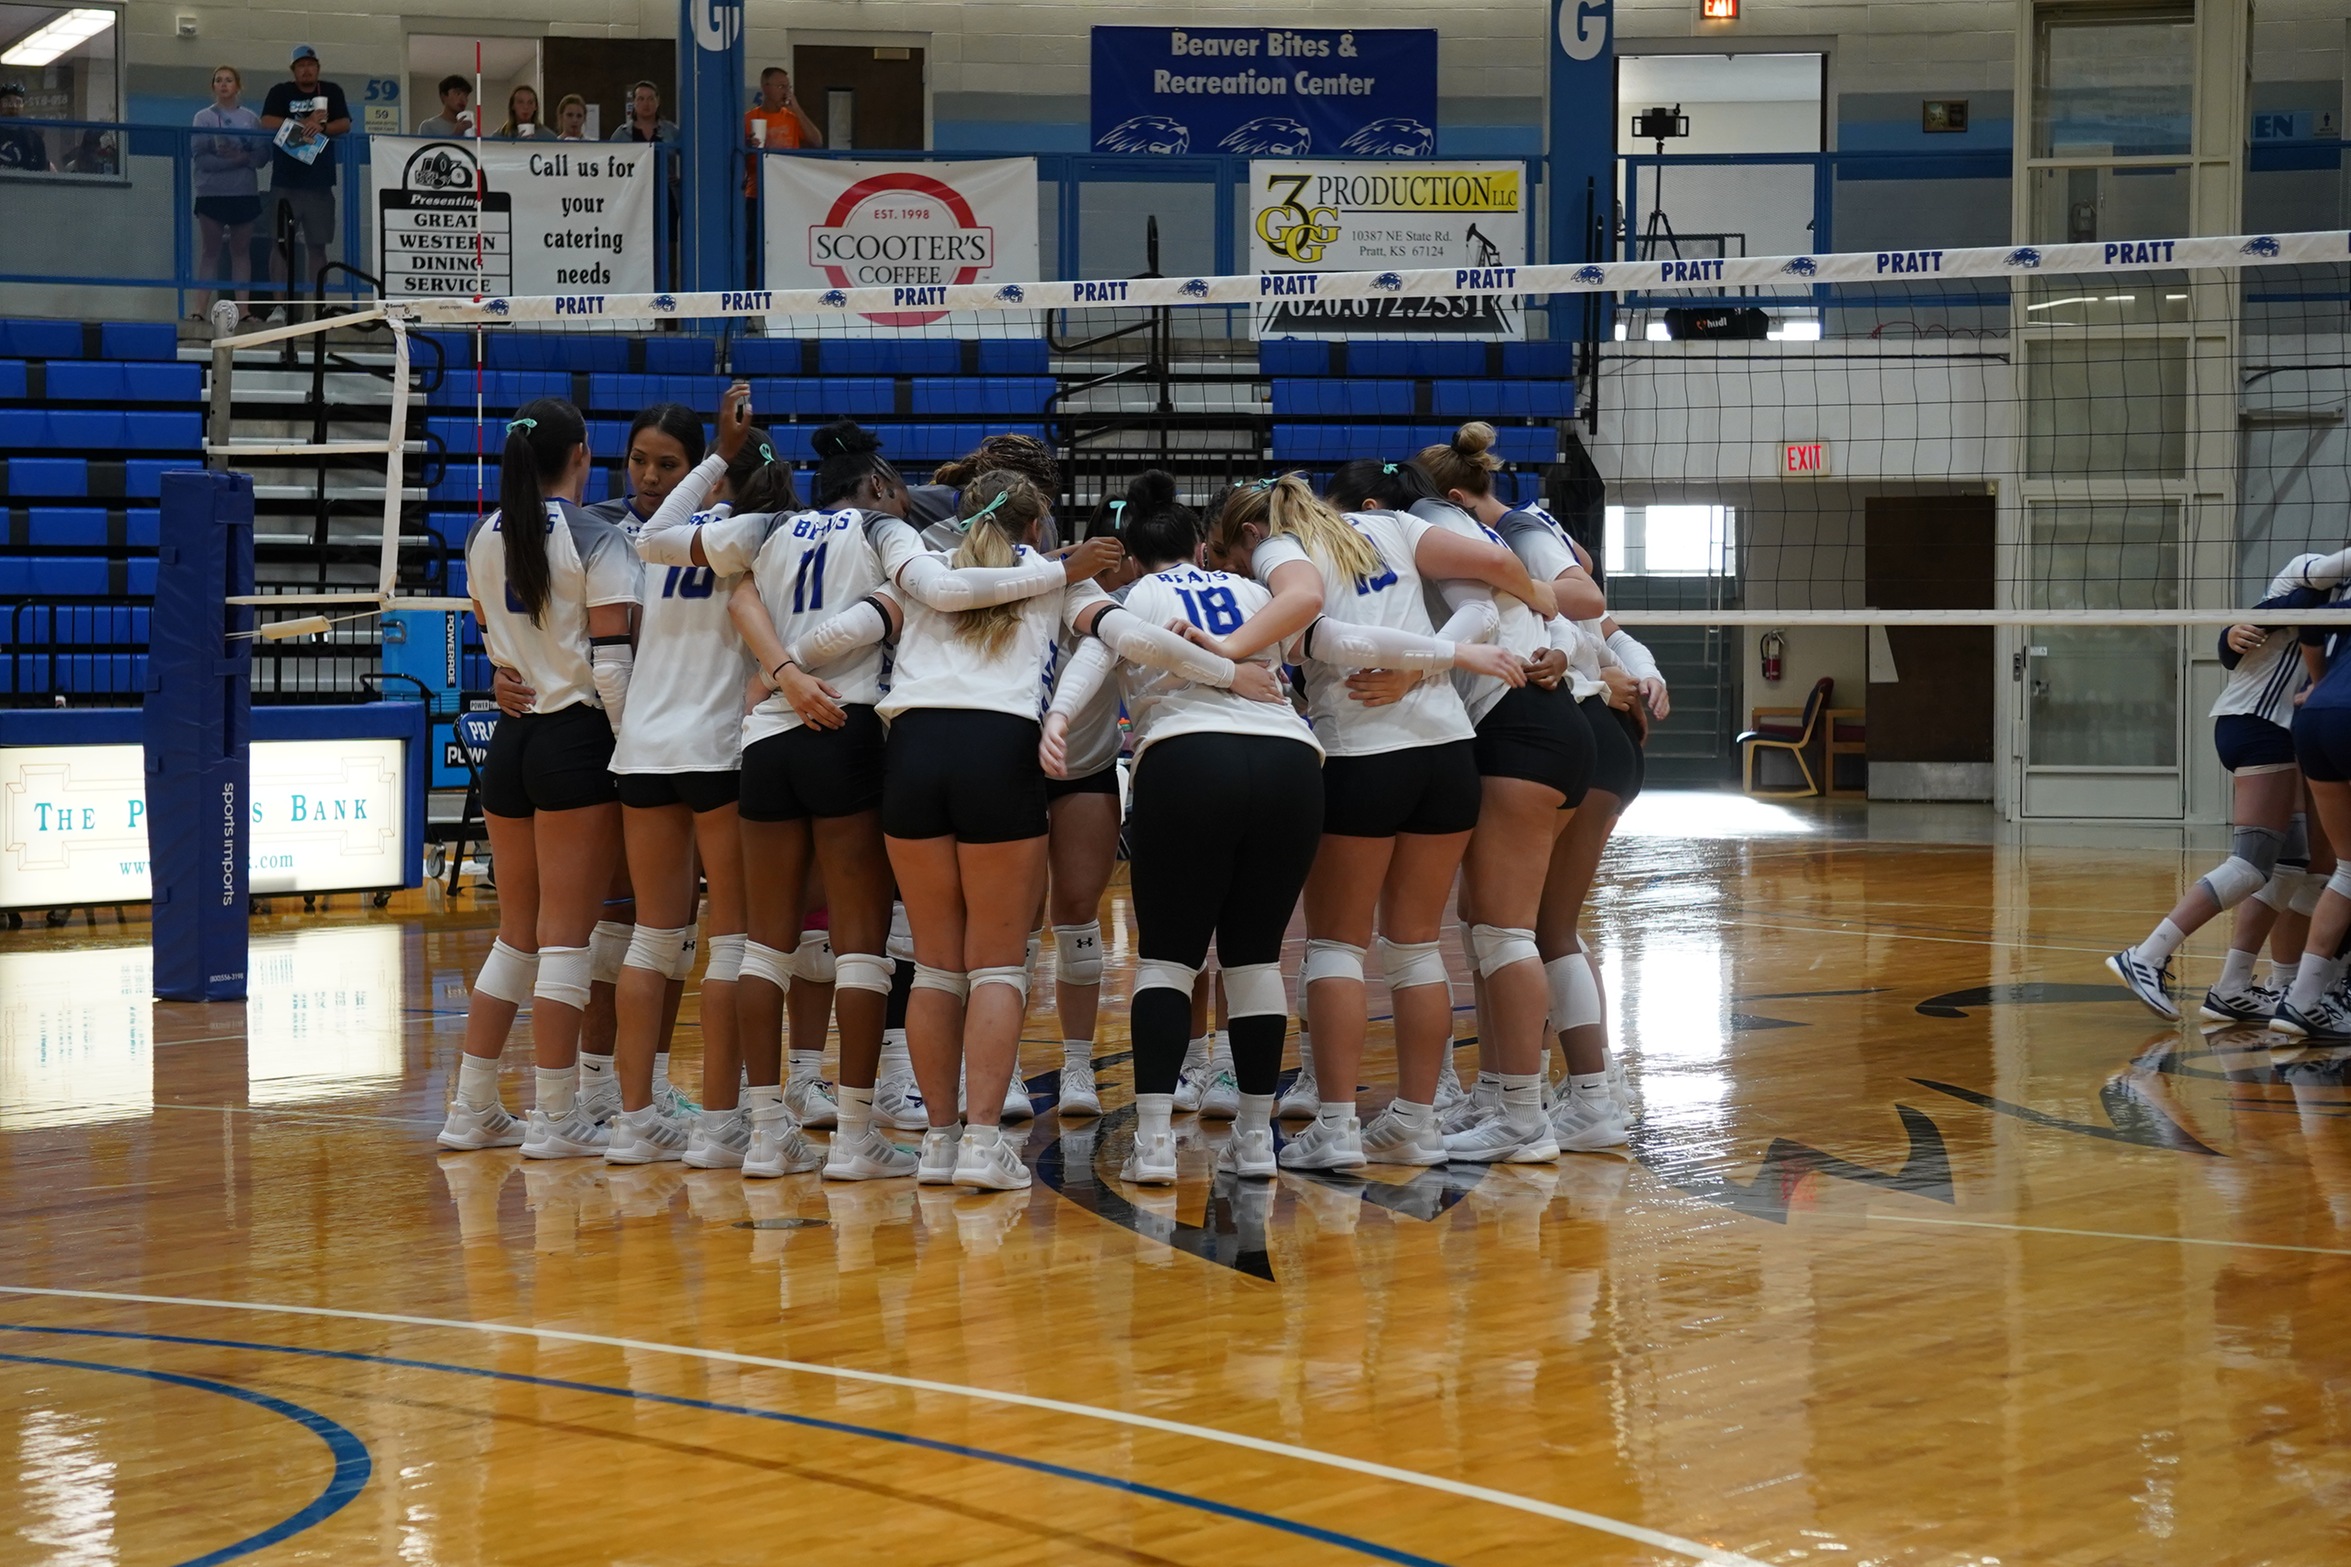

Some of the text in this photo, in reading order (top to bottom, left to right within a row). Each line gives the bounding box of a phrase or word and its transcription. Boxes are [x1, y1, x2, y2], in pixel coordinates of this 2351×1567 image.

[1171, 31, 1358, 58] Beaver Bites &
[364, 80, 399, 101] 59
[1154, 69, 1375, 96] Recreation Center
[2254, 115, 2293, 137] EN
[530, 154, 635, 178] Call us for
[1317, 175, 1517, 206] PRODUCTION LLC
[562, 196, 604, 217] your
[874, 209, 930, 219] EST. 1998
[414, 213, 478, 228] GREAT
[400, 234, 496, 250] WESTERN
[543, 227, 623, 254] catering
[1351, 230, 1453, 242] 10387 NE State Rd.
[816, 234, 985, 262] SCOOTER'S
[1359, 246, 1444, 258] Pratt, KS 67124
[2105, 241, 2175, 264] PRATT
[412, 256, 483, 271] DINING
[557, 262, 611, 285] needs
[1661, 260, 1724, 282] PRATT
[1877, 252, 1943, 274] PRATT
[404, 276, 491, 292] SERVICE
[858, 265, 942, 285] COFFEE
[1260, 275, 1318, 296] PRATT
[1456, 268, 1516, 290] PRATT
[722, 291, 773, 311] PRATT
[894, 287, 947, 306] PRATT
[1073, 281, 1128, 302] PRATT
[555, 296, 605, 315] PRATT
[1706, 316, 1728, 329] hudl
[1786, 444, 1823, 472] EXIT
[793, 541, 829, 614] 11
[1174, 586, 1244, 635] 18
[446, 614, 457, 685] POWERADE
[34, 801, 96, 831] THE
[291, 793, 368, 821] BANK
[221, 782, 236, 906] sports imports
